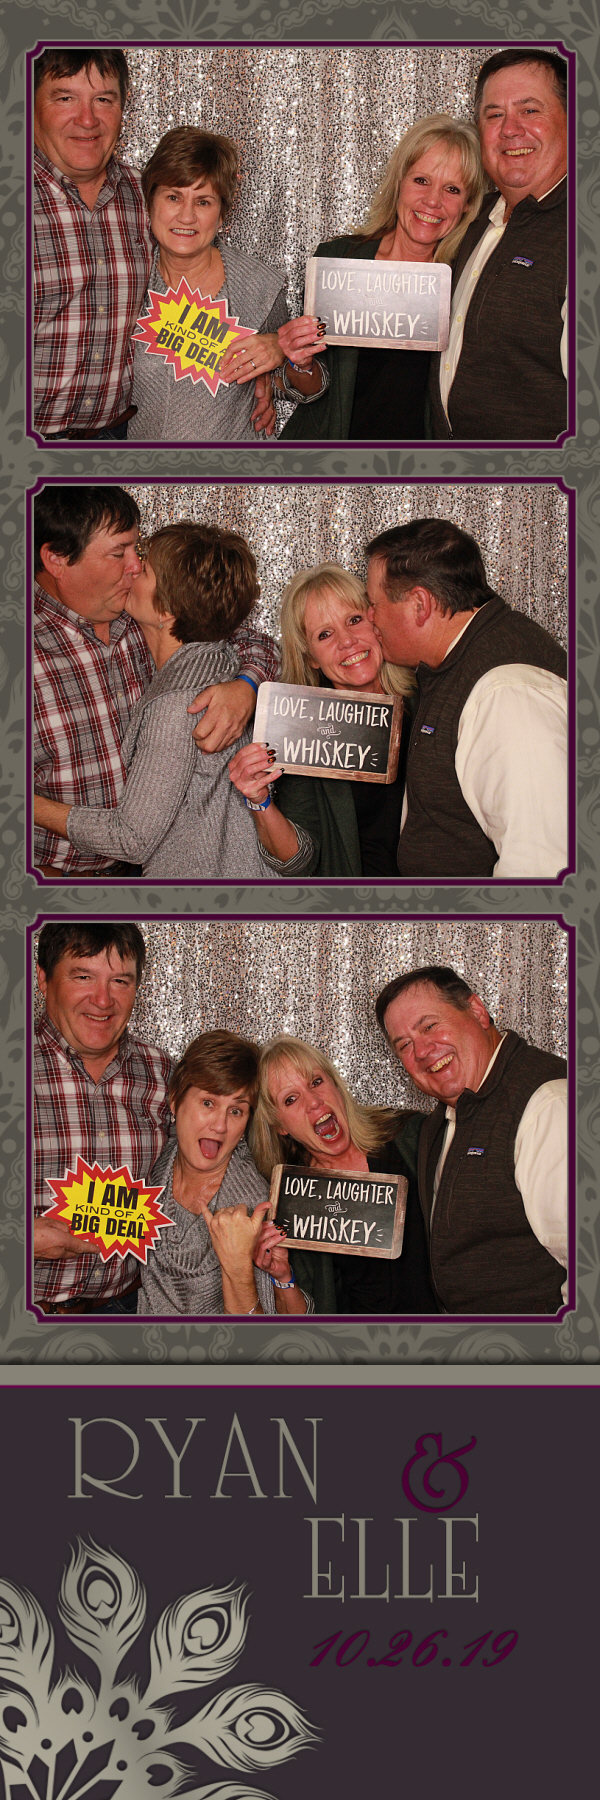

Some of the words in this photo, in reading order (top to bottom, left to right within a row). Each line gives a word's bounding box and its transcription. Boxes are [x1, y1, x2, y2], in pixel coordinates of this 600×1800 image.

[321, 270, 361, 294] LOVE,
[366, 272, 437, 295] LAUGHTER
[165, 321, 197, 339] KIND
[199, 337, 219, 349] OF
[178, 304, 191, 324] I
[190, 311, 230, 343] AM
[333, 309, 420, 338] WHISKEY
[155, 327, 185, 353] BIG
[273, 696, 314, 722] LOVE,
[318, 701, 389, 728] LAUGHTER
[318, 723, 341, 738] and
[283, 737, 372, 769] WHISKEY
[87, 1181, 95, 1204] I
[101, 1183, 139, 1210] AM
[284, 1177, 322, 1200] LOVE,
[326, 1181, 394, 1205] LAUGHTER
[75, 1204, 110, 1216] KIND
[114, 1210, 134, 1218] OF
[136, 1213, 146, 1221] A
[325, 1201, 347, 1216] and
[70, 1213, 100, 1234] BIG
[105, 1217, 146, 1239] DEAL
[293, 1214, 377, 1245] WHISKEY
